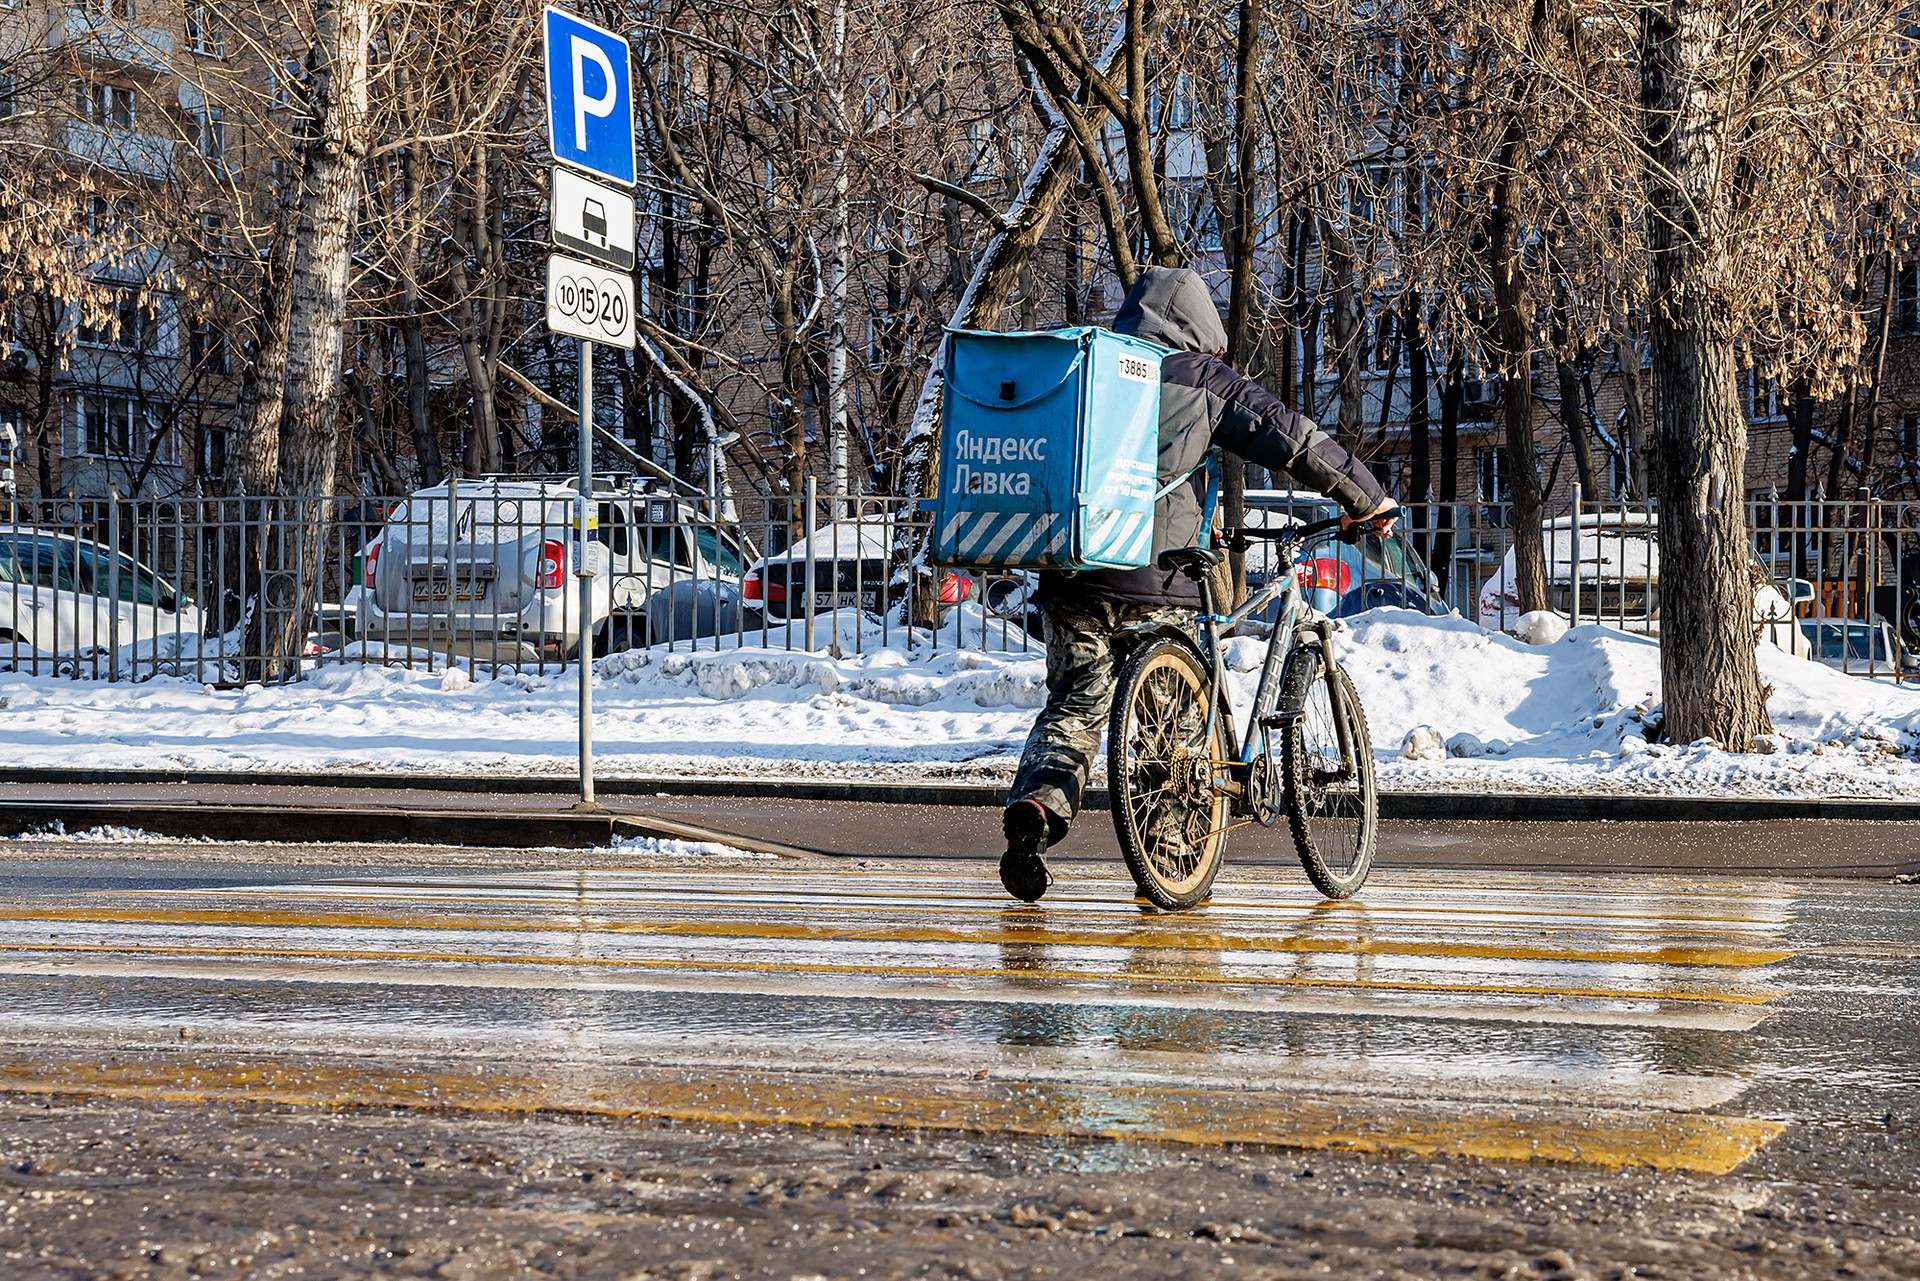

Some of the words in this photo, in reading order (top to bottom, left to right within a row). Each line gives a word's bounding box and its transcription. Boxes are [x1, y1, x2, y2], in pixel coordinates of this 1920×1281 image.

[570, 34, 617, 152] P
[561, 285, 574, 306] 10
[580, 287, 594, 314] 15
[601, 292, 623, 324] 20
[955, 430, 1047, 464] Яндекс
[952, 464, 1030, 495] Лавка
[1120, 484, 1130, 496] 10
